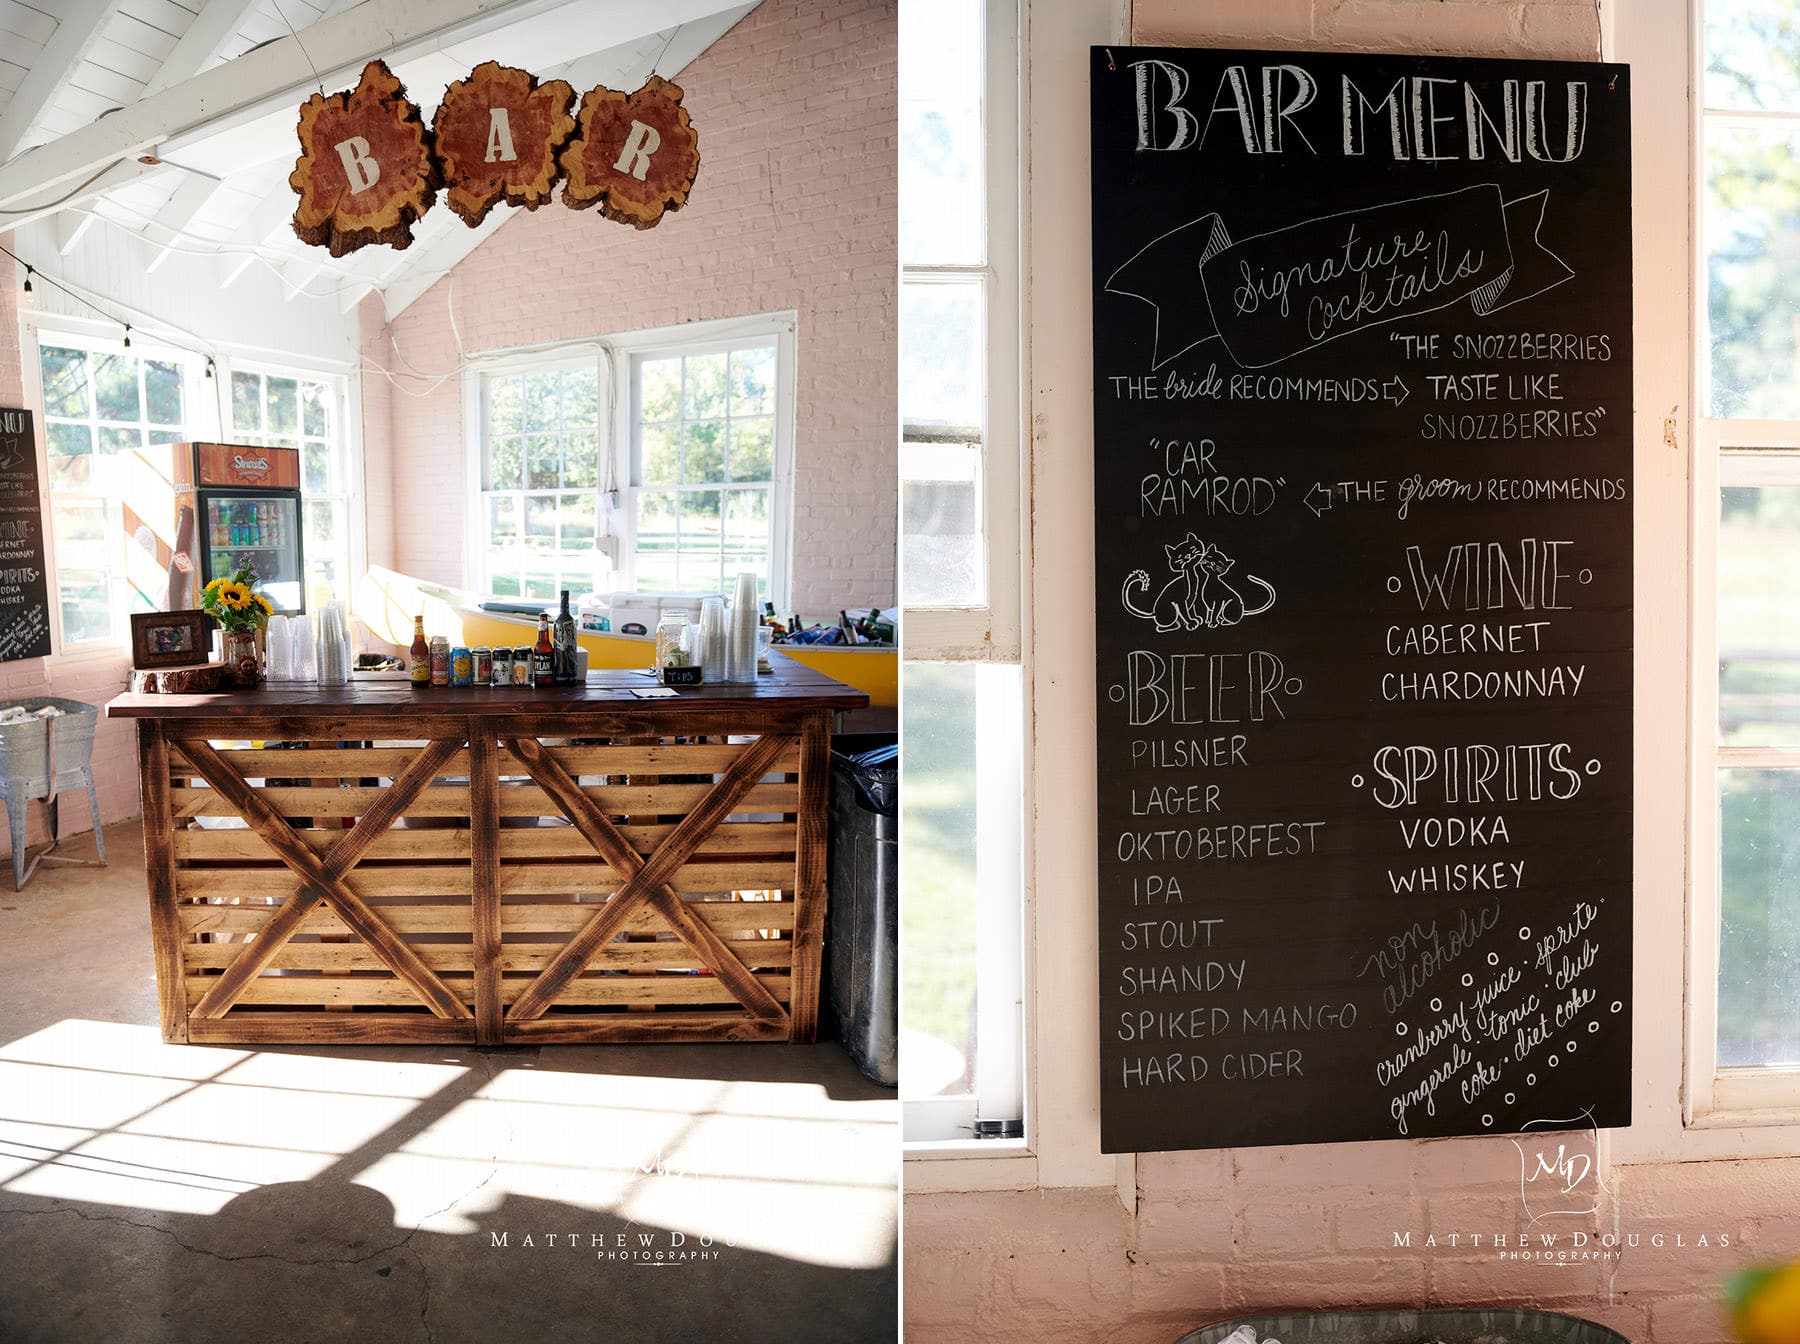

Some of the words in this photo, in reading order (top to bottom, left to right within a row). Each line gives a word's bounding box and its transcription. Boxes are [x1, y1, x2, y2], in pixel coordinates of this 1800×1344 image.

[1127, 59, 1318, 156] BAR
[1341, 72, 1588, 163] MENU
[334, 107, 661, 196] BAR
[1233, 223, 1430, 317] Signature
[1307, 230, 1484, 340] Cocktails
[1453, 334, 1612, 361] SNOZZBERRIES
[1108, 375, 1158, 400] THE
[1164, 363, 1223, 400] bride
[1229, 377, 1378, 402] RECOMMENDS
[1426, 374, 1499, 401] TASTE
[1508, 374, 1564, 400] LIKE
[1337, 480, 1386, 502] THE
[1398, 478, 1482, 519] groom
[1488, 477, 1626, 501] RECOMMENDS
[1406, 537, 1574, 611] WINE
[1386, 622, 1551, 656] CABERNET
[1127, 650, 1286, 725] BEER
[1382, 664, 1586, 701] CHARDONNAY
[1132, 734, 1248, 769] PILSNER
[1372, 743, 1582, 809] SPIRITS
[1131, 784, 1222, 816] LAGER
[1117, 821, 1326, 862] OKTOBERFEST
[1399, 815, 1510, 849] VODKA
[1132, 875, 1183, 906] IPA
[1388, 860, 1525, 894] WHISKEY
[1120, 918, 1225, 951] STOUT
[1355, 918, 1438, 978] non
[1383, 896, 1501, 1016] alcoholic
[1119, 959, 1246, 997] SHANDY
[1376, 1007, 1473, 1087] cranberry
[1470, 966, 1522, 1030] juice
[1534, 901, 1598, 969] sprite
[1117, 1007, 1230, 1042] SPIKED
[1242, 1003, 1358, 1033] MANGO
[1390, 1043, 1472, 1136] gingerale
[1483, 993, 1540, 1042] tonic
[1555, 943, 1600, 991] club
[1461, 1063, 1502, 1105] coke
[1513, 1017, 1552, 1063] diet
[1555, 985, 1597, 1030] coke
[1121, 1052, 1209, 1089] HARD
[1222, 1049, 1304, 1080] CIDER
